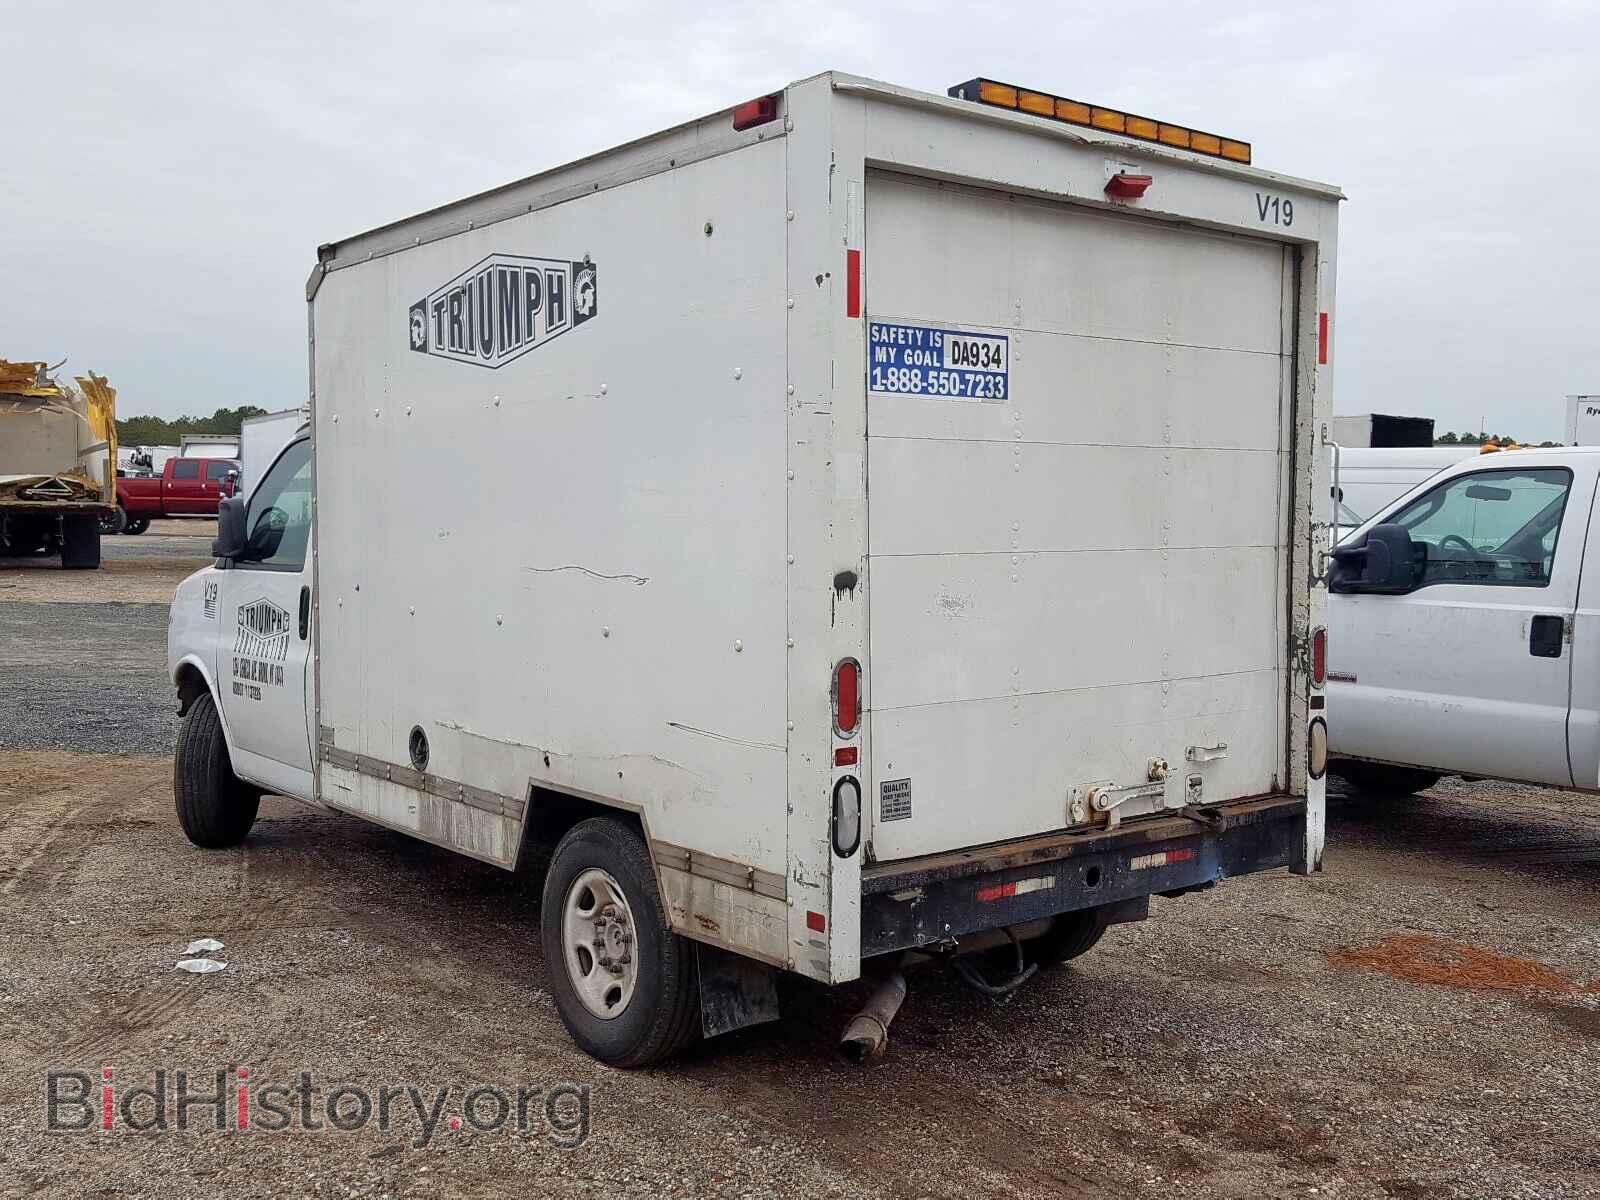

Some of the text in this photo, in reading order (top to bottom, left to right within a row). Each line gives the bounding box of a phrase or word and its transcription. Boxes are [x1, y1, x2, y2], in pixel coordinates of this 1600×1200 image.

[1256, 193, 1293, 227] V19
[432, 264, 568, 360] TRIUMPH
[871, 325, 943, 348] SAFETY IS
[875, 346, 941, 367] MY GOAL
[951, 340, 1002, 369] DA934
[872, 366, 1005, 399] 1-888-550-7233
[204, 580, 218, 600] V19
[245, 603, 282, 634] TRIUMPH
[883, 782, 909, 793] QUALITY
